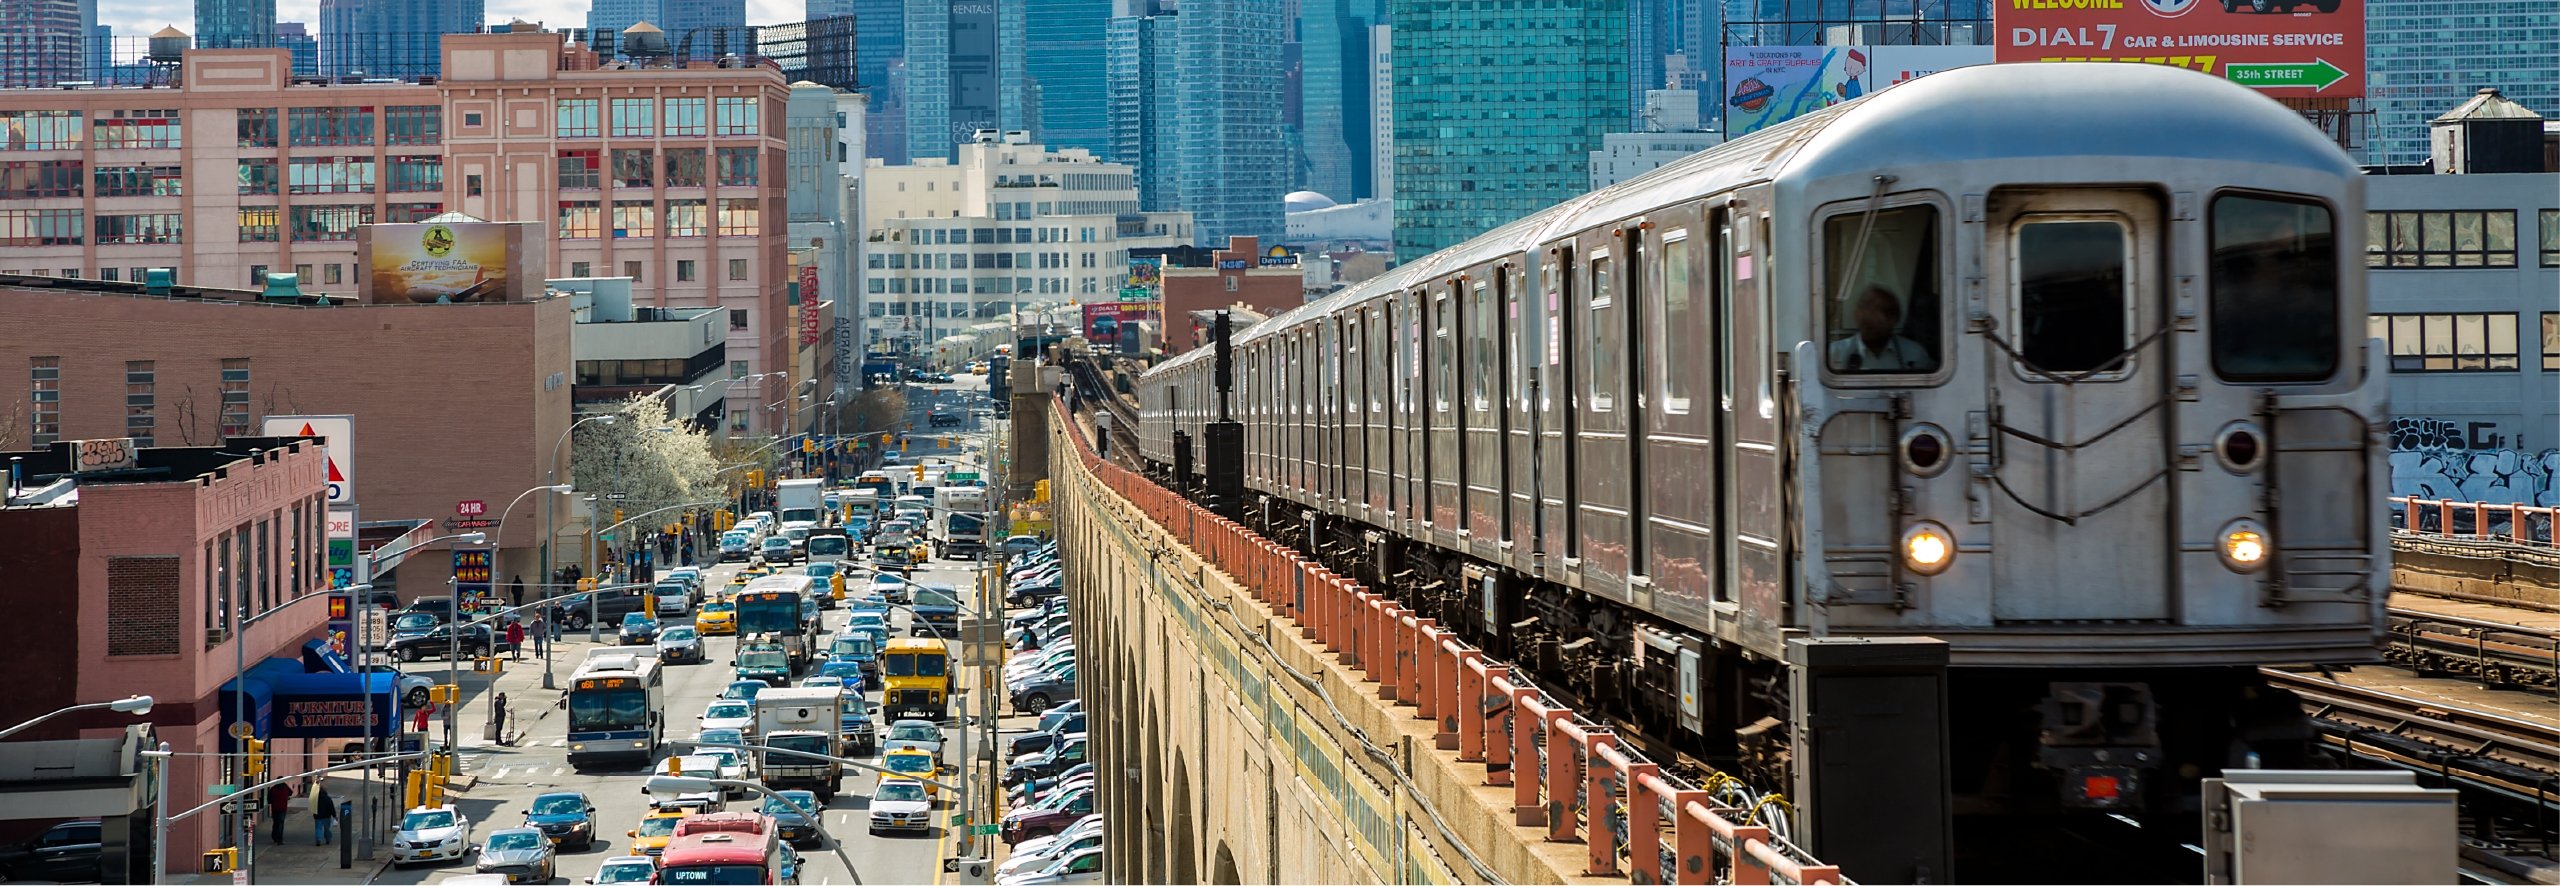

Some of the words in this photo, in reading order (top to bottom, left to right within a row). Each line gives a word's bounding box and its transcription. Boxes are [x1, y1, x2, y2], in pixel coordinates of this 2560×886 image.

[952, 4, 993, 14] RENTALS
[2124, 36, 2157, 47] CAR
[2161, 36, 2175, 47] &
[2178, 34, 2269, 47] LIMOUSINE
[2272, 33, 2344, 46] SERVICE
[1729, 59, 1745, 67] ART
[1757, 59, 1781, 67] CRAFT
[1785, 58, 1821, 67] SUPPLIES
[2236, 69, 2261, 79] 35th
[2264, 69, 2304, 79] STREET
[1261, 257, 1282, 265] Days
[460, 503, 469, 514] 24
[328, 521, 349, 532] ORE
[456, 568, 489, 581] WASH
[283, 715, 298, 728] &
[675, 871, 707, 880] UPTOWN
